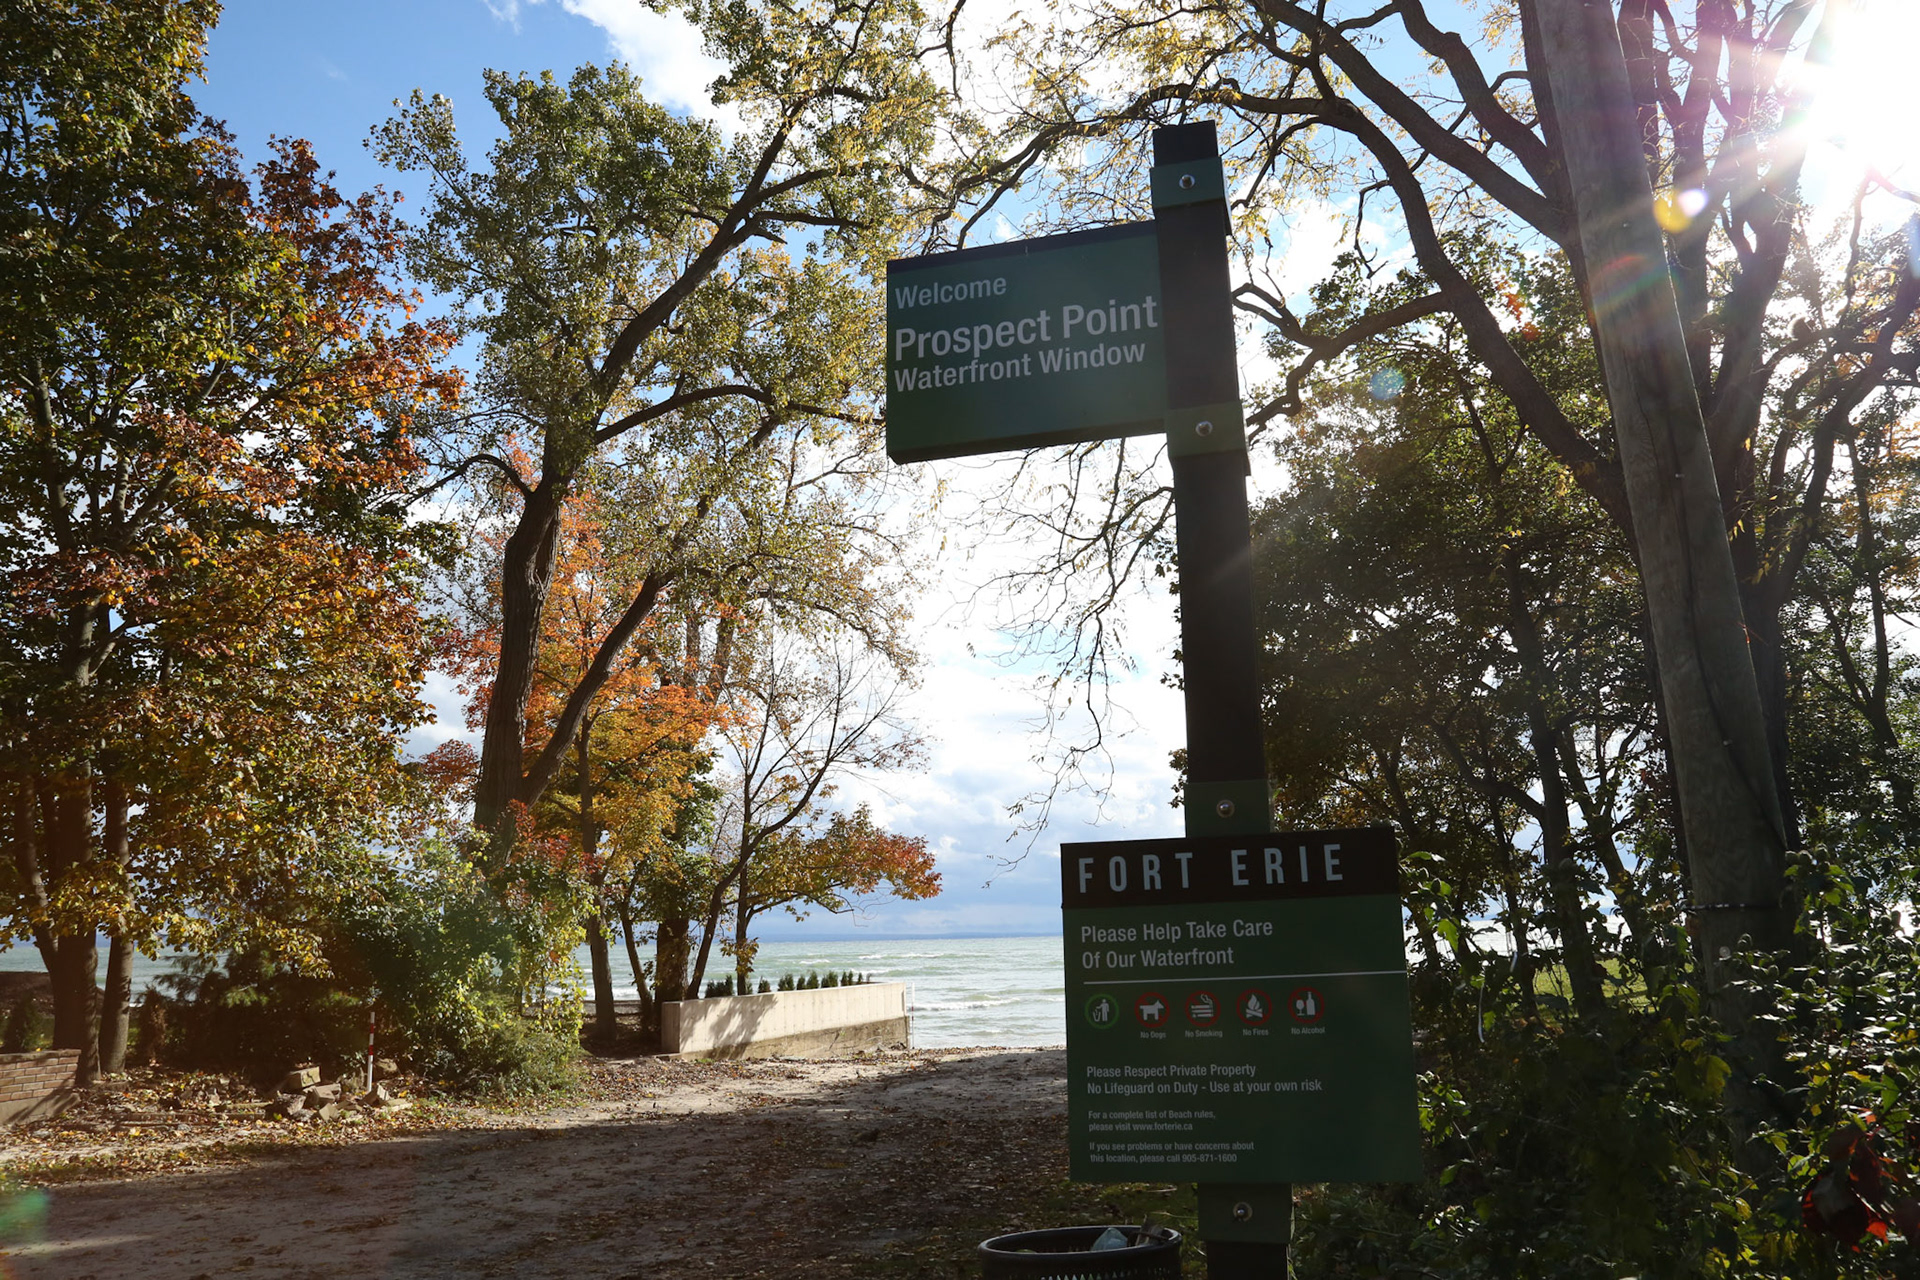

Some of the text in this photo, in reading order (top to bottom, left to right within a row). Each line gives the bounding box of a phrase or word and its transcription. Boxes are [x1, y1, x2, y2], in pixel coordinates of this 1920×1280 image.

[895, 278, 1006, 308] Welcome
[896, 296, 1157, 361] Prospect Point
[895, 343, 1145, 392] Waterfront Window
[1079, 844, 1343, 893] FORT ERIE
[1082, 920, 1272, 943] Please Help Take Care
[1082, 947, 1233, 969] Of Our Waterfront
[1141, 1030, 1167, 1040] No Dogs
[1185, 1029, 1223, 1038] No Smoking
[1243, 1027, 1269, 1036] No Fires
[1291, 1026, 1326, 1035] No Alcohol
[1087, 1064, 1255, 1078] Please Respect Private Property
[1088, 1083, 1101, 1094] No
[1105, 1082, 1154, 1096] Lifeguard
[1158, 1085, 1170, 1093] on
[1174, 1082, 1198, 1095] Duty
[1210, 1081, 1229, 1092] Use
[1233, 1081, 1244, 1092] at
[1247, 1083, 1271, 1094] your
[1275, 1082, 1297, 1091] own
[1301, 1079, 1322, 1091] risk
[1089, 1111, 1100, 1119] For
[1109, 1111, 1143, 1120] complete
[1159, 1110, 1166, 1118] of
[1169, 1110, 1192, 1118] Beach
[1194, 1110, 1215, 1118] rules,
[1089, 1123, 1113, 1132] please
[1132, 1122, 1193, 1130] www.forterie.ca
[1090, 1142, 1095, 1151] If
[1097, 1144, 1110, 1152] you
[1127, 1142, 1162, 1151] problems
[1175, 1142, 1192, 1150] have
[1232, 1142, 1254, 1150] about
[1090, 1154, 1237, 1163] this location, please call 905-871-1600
